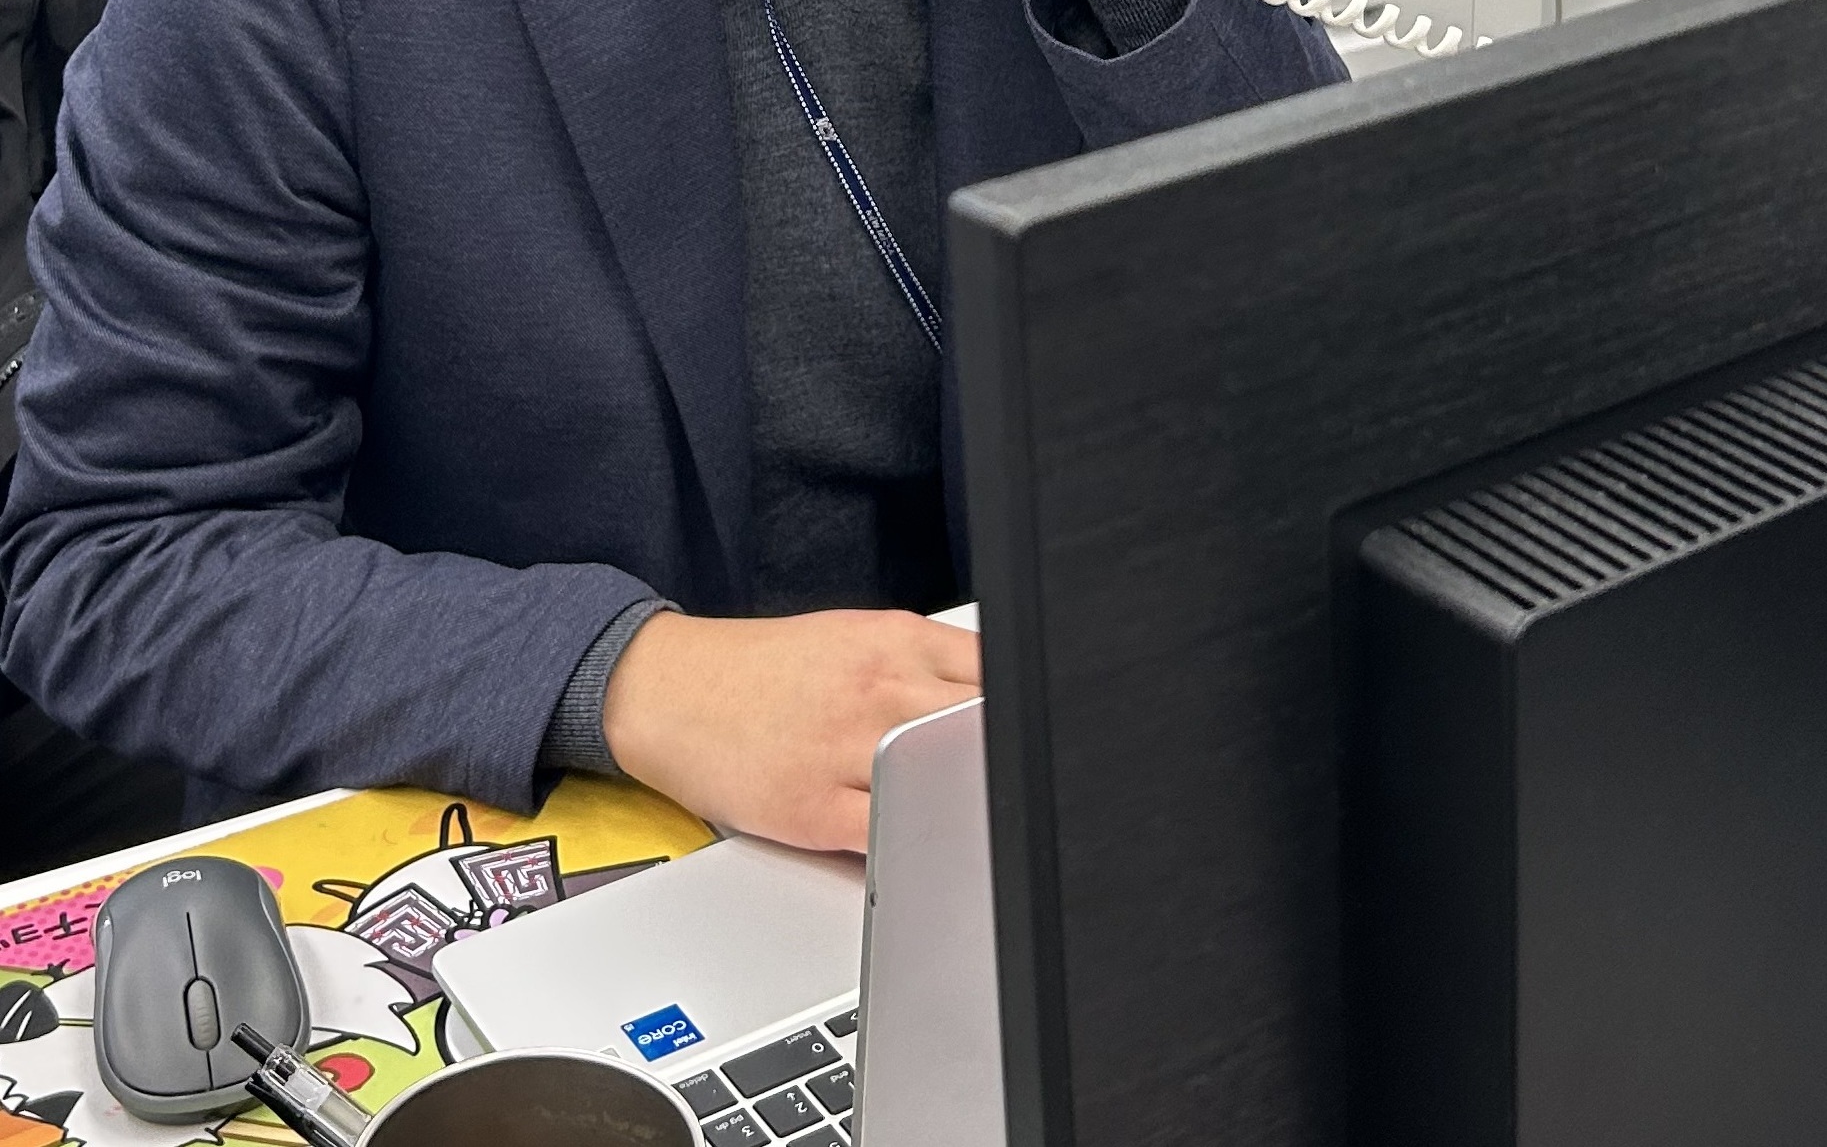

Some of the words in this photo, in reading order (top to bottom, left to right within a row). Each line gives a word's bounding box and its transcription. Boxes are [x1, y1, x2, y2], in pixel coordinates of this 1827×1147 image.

[162, 869, 202, 888] logi
[673, 1032, 697, 1047] intel
[784, 1030, 812, 1044] insert
[679, 1073, 709, 1089] delete
[829, 1070, 849, 1083] end
[794, 1101, 808, 1113] 2
[715, 1121, 729, 1131] dn
[729, 1114, 744, 1125] pg
[741, 1125, 755, 1137] 3
